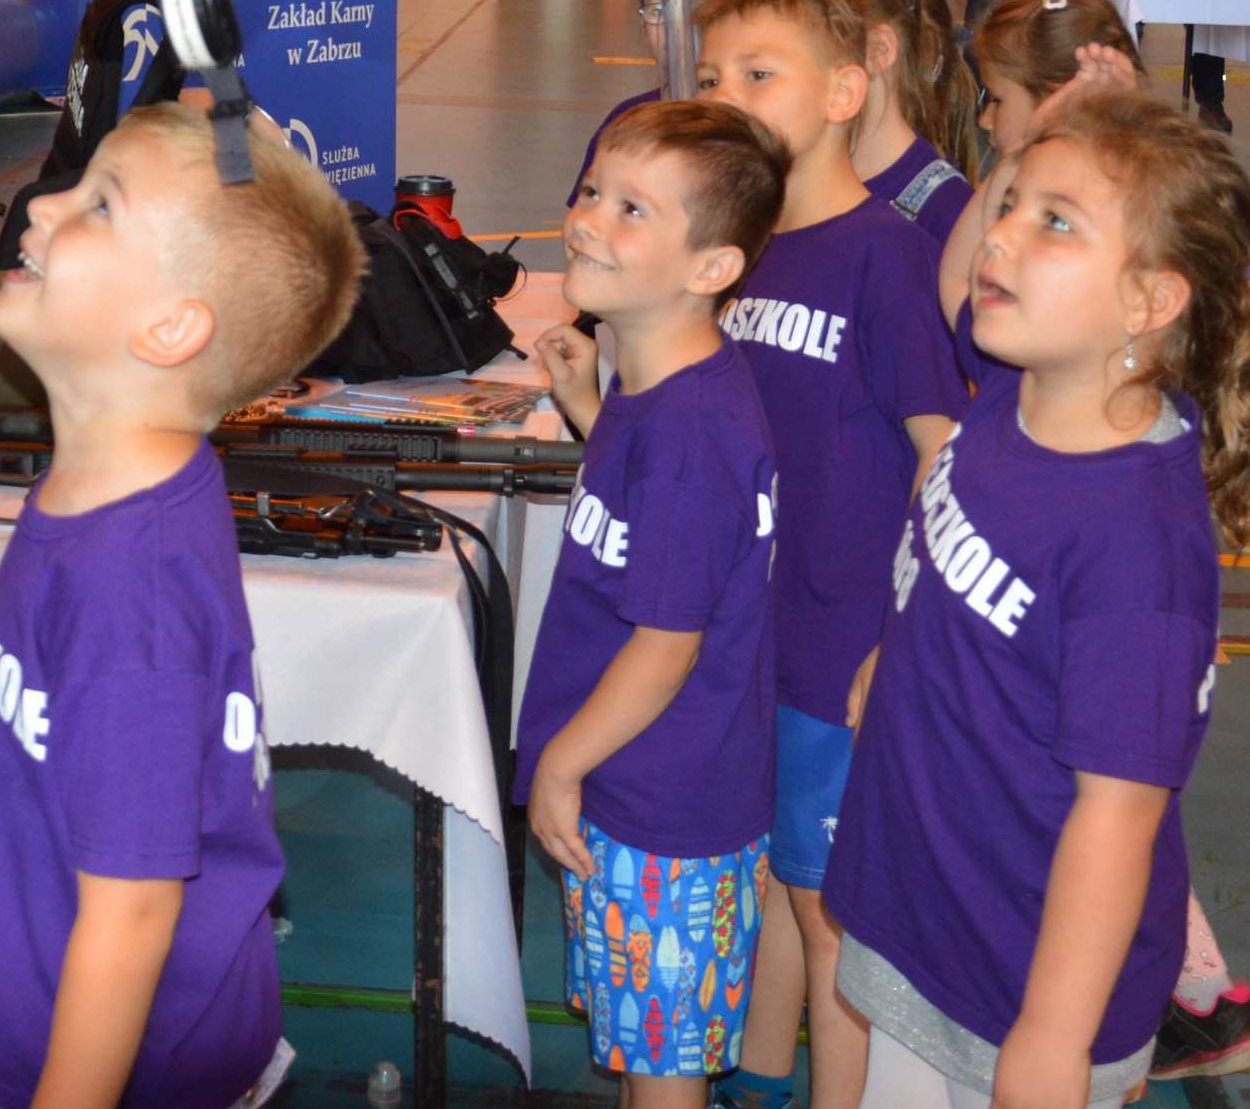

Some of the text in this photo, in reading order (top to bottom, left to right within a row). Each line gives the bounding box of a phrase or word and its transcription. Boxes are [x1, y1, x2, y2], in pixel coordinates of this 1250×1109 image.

[267, 0, 375, 30] Zakład Karny
[287, 37, 363, 66] w Zabrzu
[322, 145, 360, 166] SŁUŻBA
